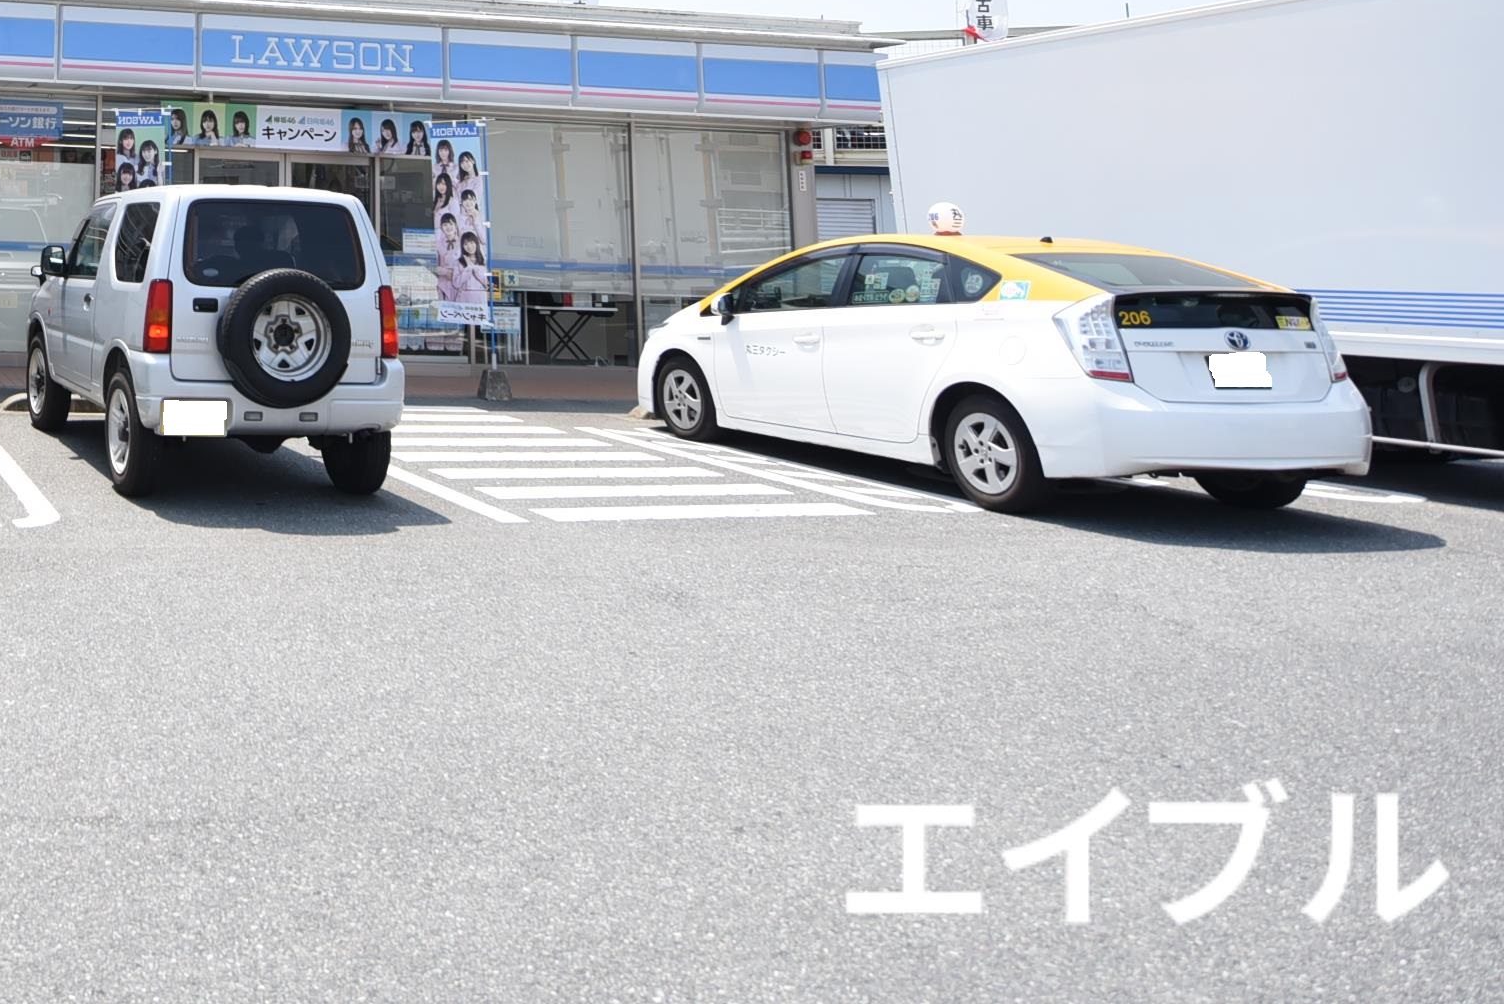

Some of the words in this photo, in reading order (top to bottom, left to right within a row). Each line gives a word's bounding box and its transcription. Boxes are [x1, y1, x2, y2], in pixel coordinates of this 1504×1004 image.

[231, 35, 415, 73] LAWSON
[261, 126, 337, 142] キャンペーン
[10, 137, 35, 148] ATM
[1118, 310, 1152, 326] 206
